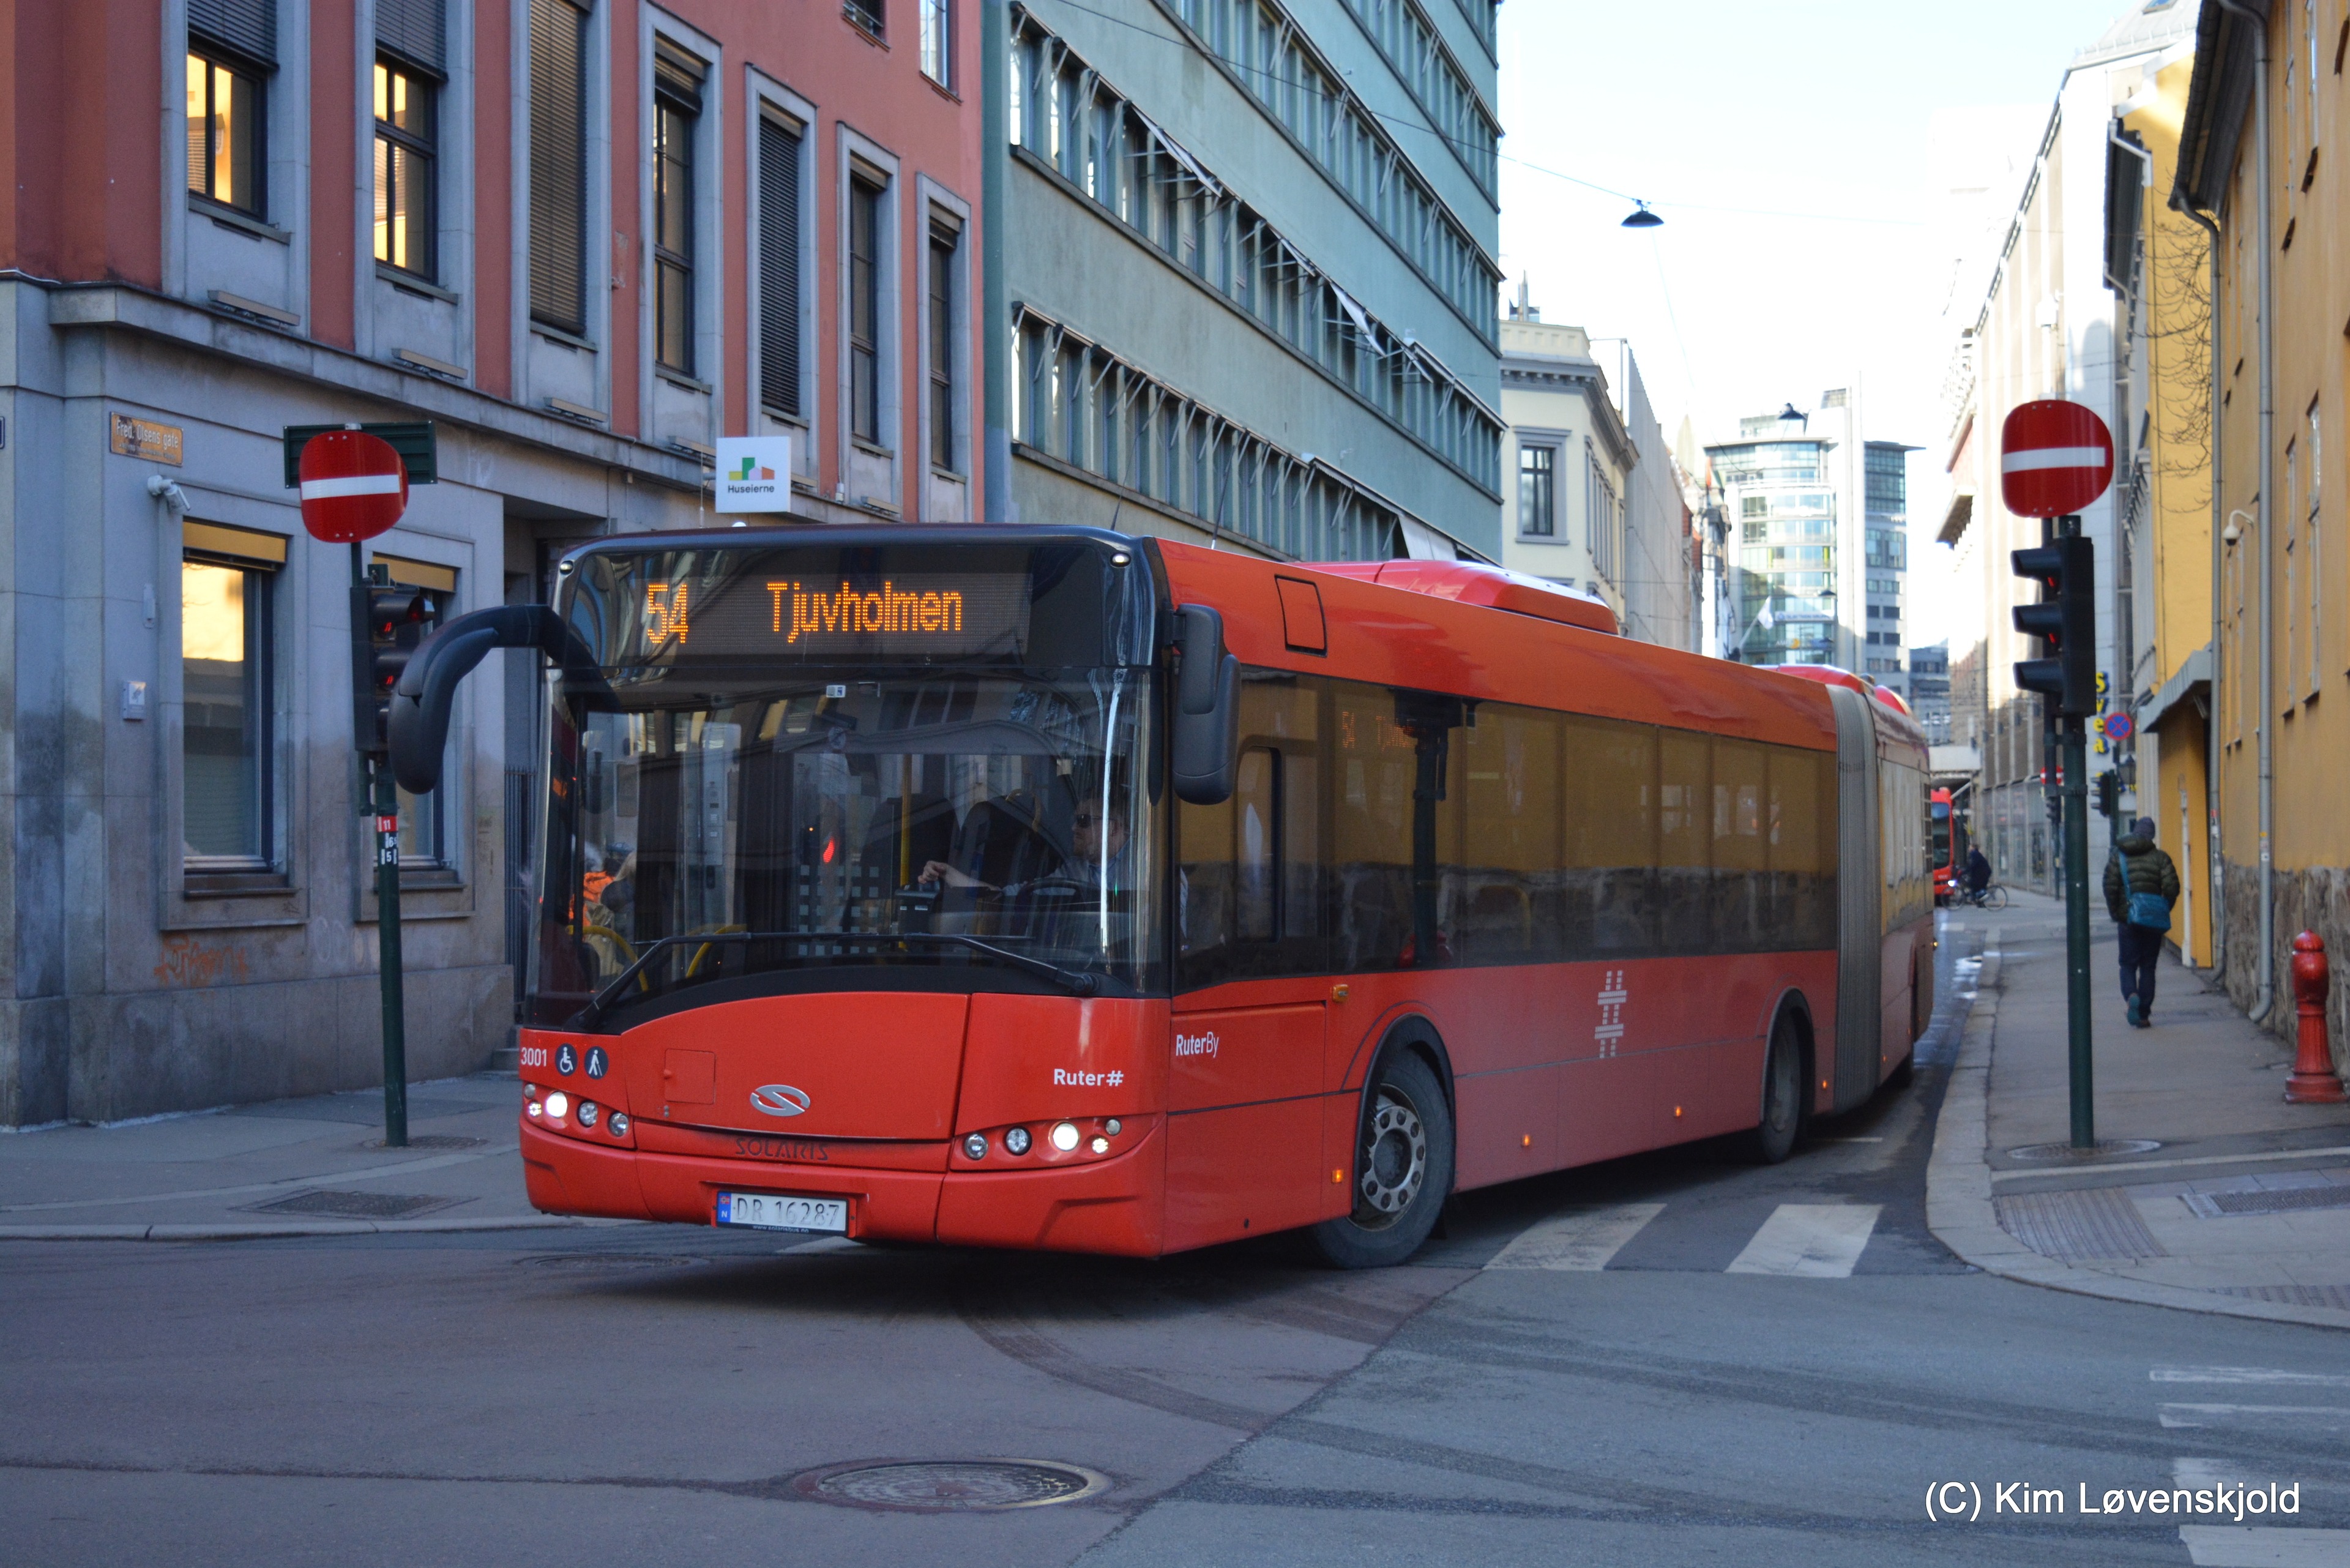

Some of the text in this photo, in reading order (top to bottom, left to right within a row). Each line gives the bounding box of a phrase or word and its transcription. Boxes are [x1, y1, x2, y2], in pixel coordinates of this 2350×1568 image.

[116, 417, 179, 450] Fred. Olsens gate
[727, 484, 775, 494] Huseierne
[647, 581, 963, 644] 54 Tjuvholmen
[382, 819, 391, 831] 11
[386, 851, 392, 862] 5
[521, 1047, 548, 1067] 3001
[1176, 1031, 1220, 1059] RuterBy
[736, 1136, 829, 1161] SOLARIS
[721, 1197, 840, 1227] N DR 16287
